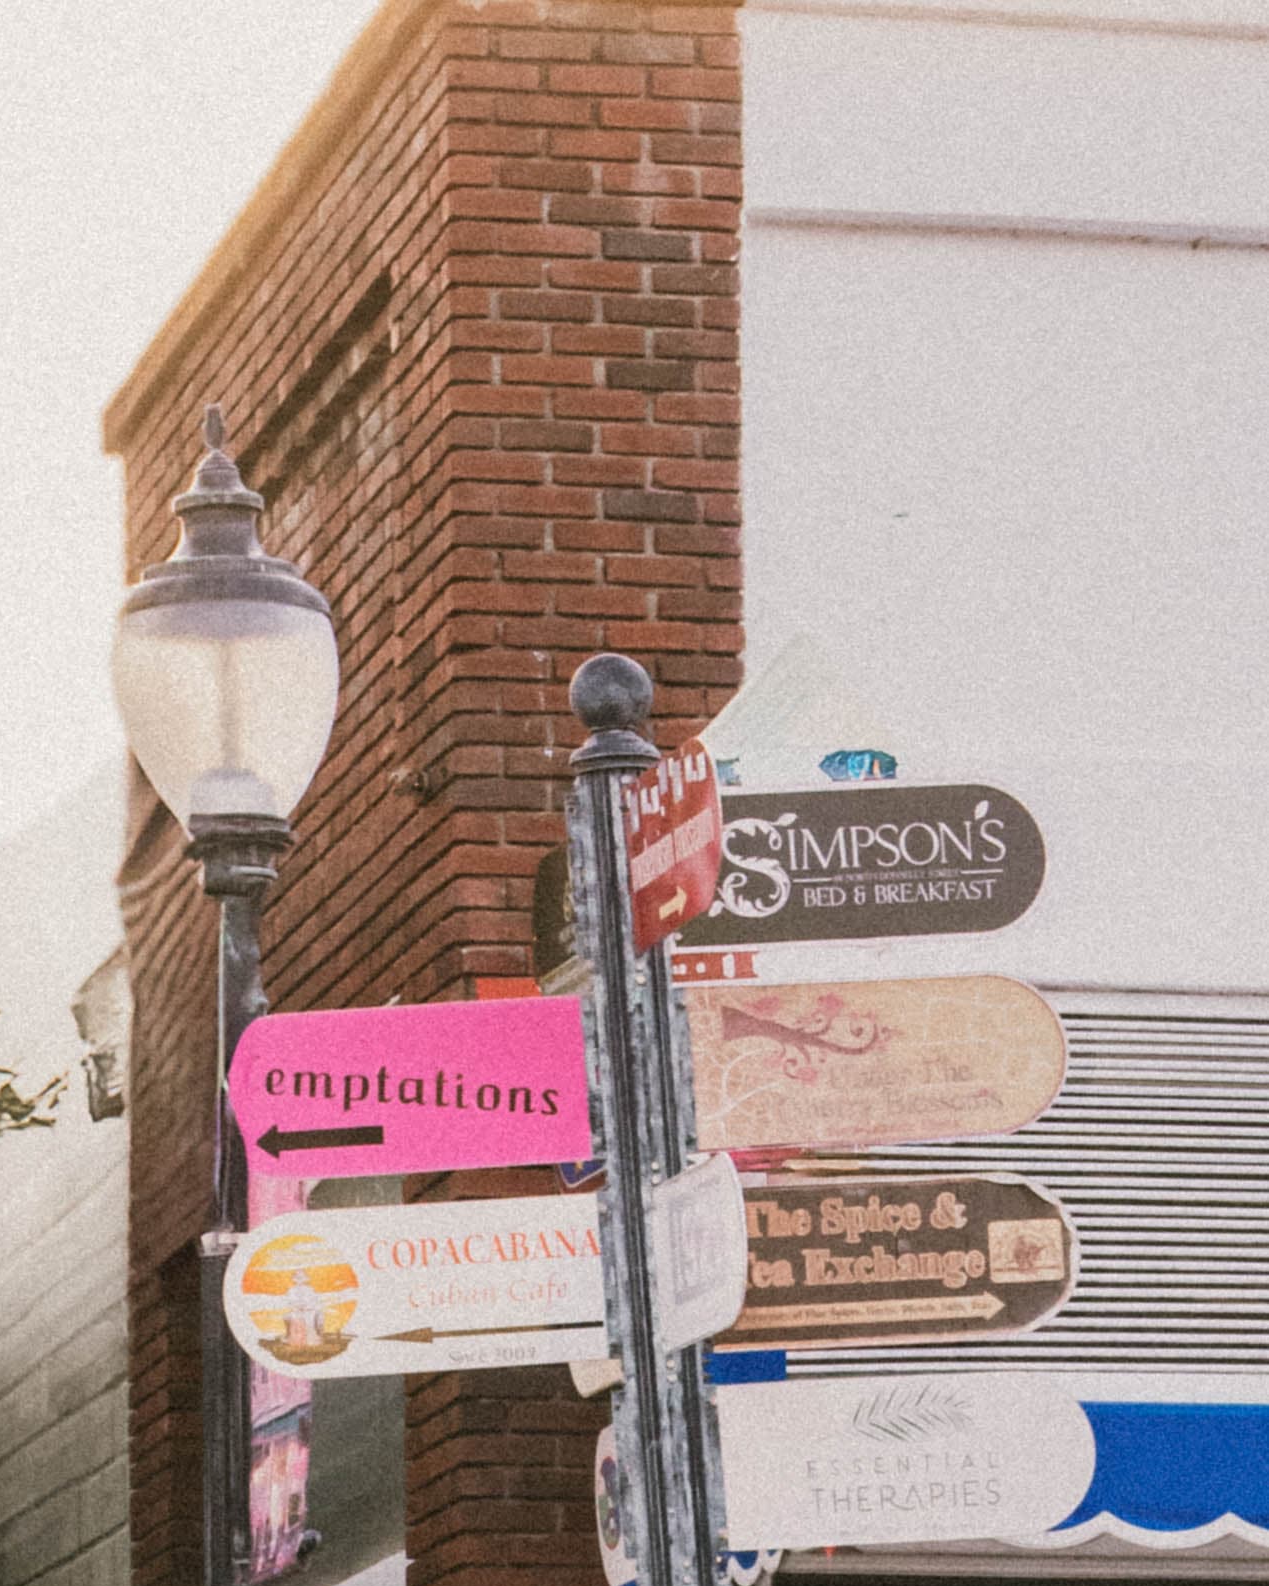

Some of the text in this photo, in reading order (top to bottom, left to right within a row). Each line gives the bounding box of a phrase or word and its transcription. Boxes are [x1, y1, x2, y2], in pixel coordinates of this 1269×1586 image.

[803, 878, 998, 908] BED & BREAKFAST
[264, 1065, 561, 1116] emptations
[745, 1191, 969, 1244] The Spice &
[368, 1227, 602, 1271] COPACABANA
[801, 1244, 987, 1290] Exchange
[806, 1451, 1000, 1479] ESSENTIAL
[809, 1479, 1002, 1516] THERAPIES
